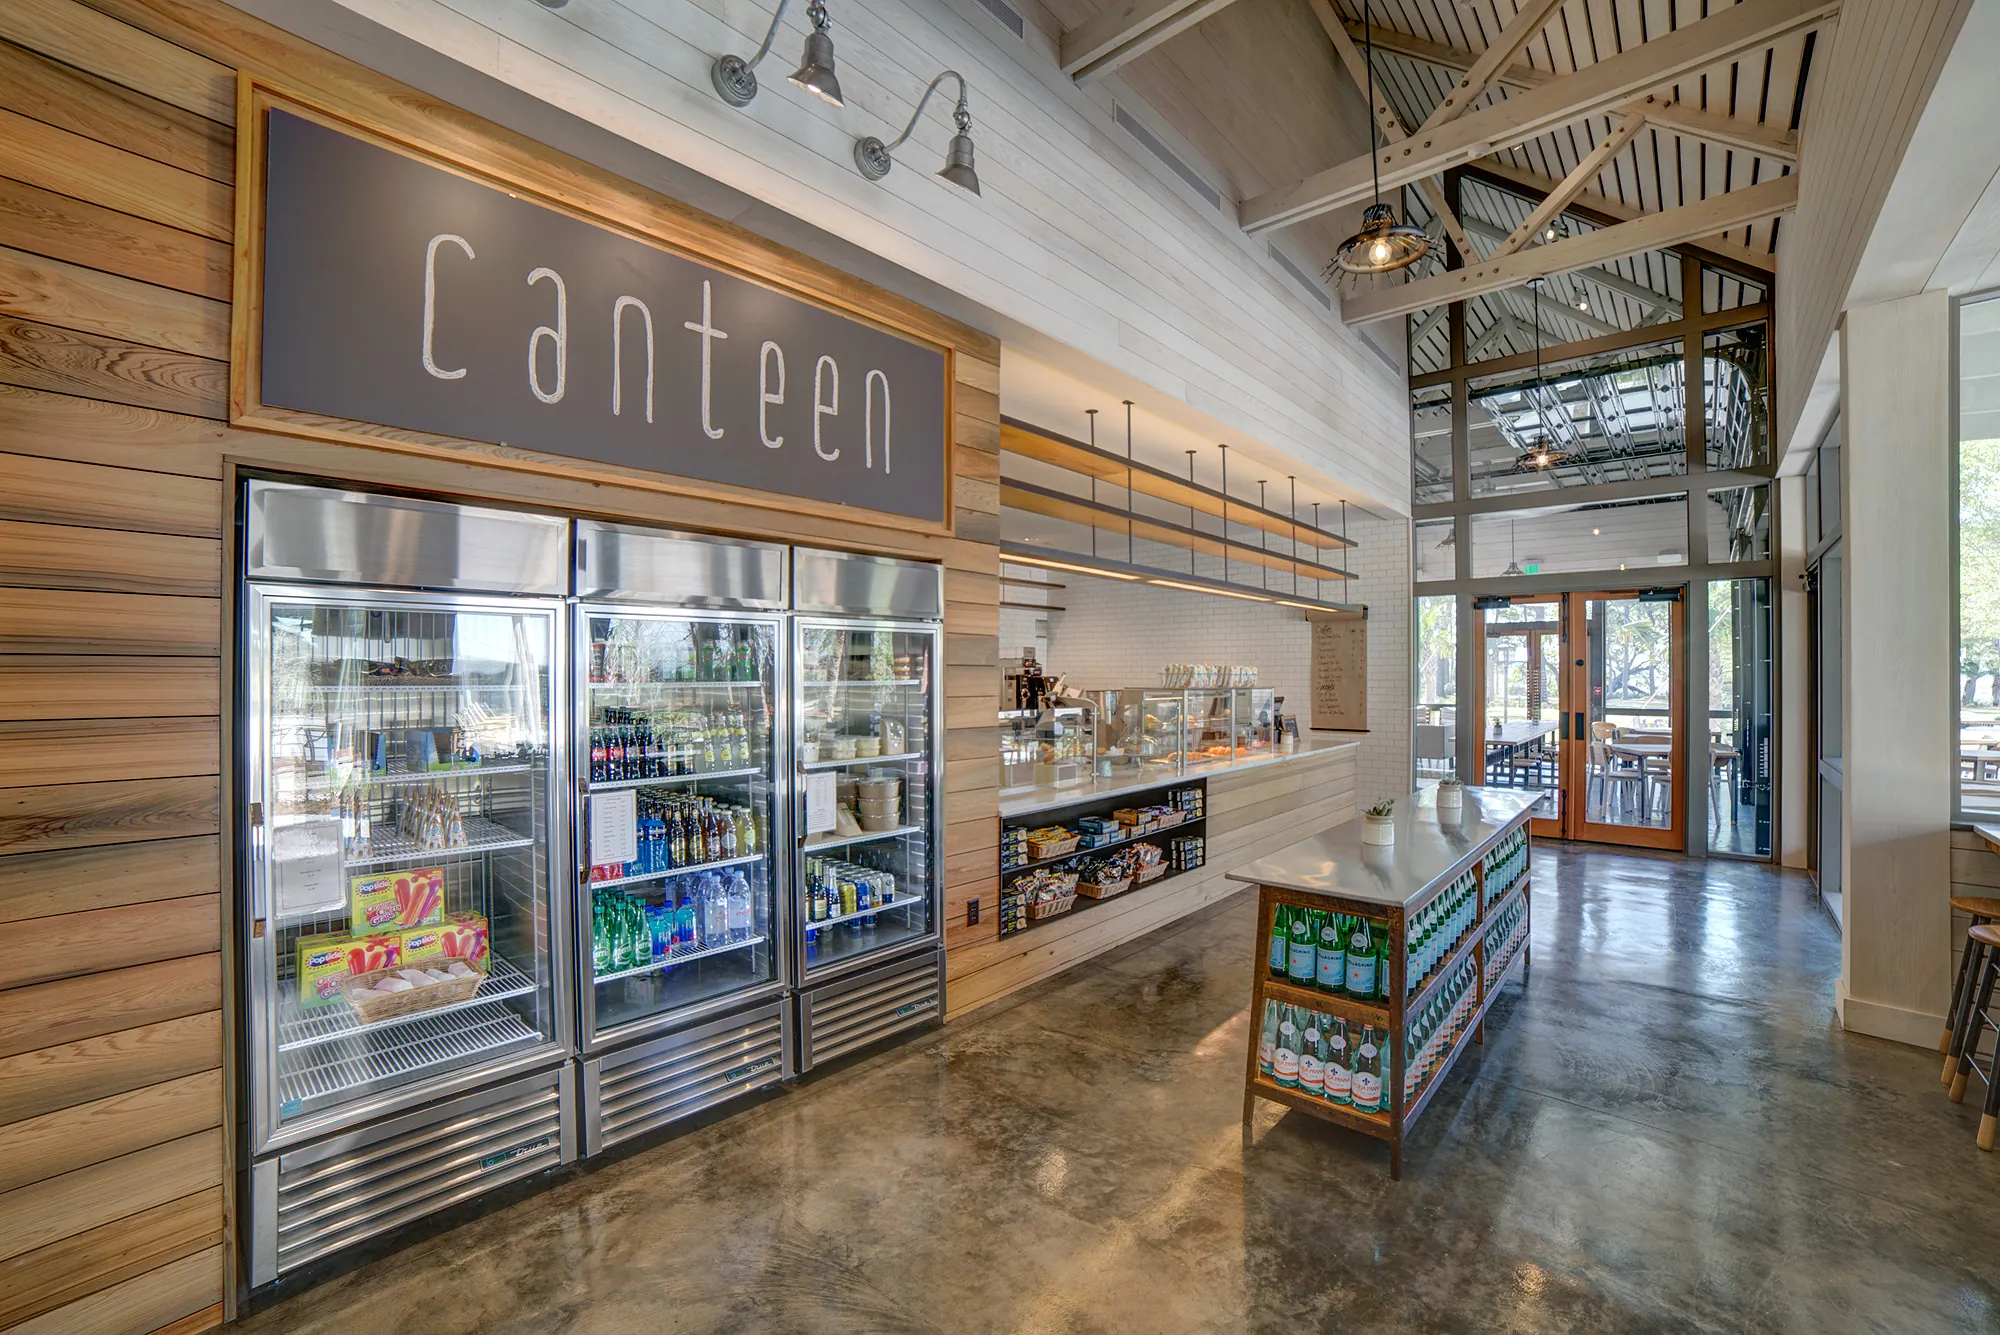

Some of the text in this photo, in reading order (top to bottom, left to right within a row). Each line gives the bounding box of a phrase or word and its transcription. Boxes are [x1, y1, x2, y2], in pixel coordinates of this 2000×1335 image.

[358, 880, 389, 893] Popsicle
[407, 934, 437, 947] Popsicle
[309, 951, 342, 965] Popsicle
